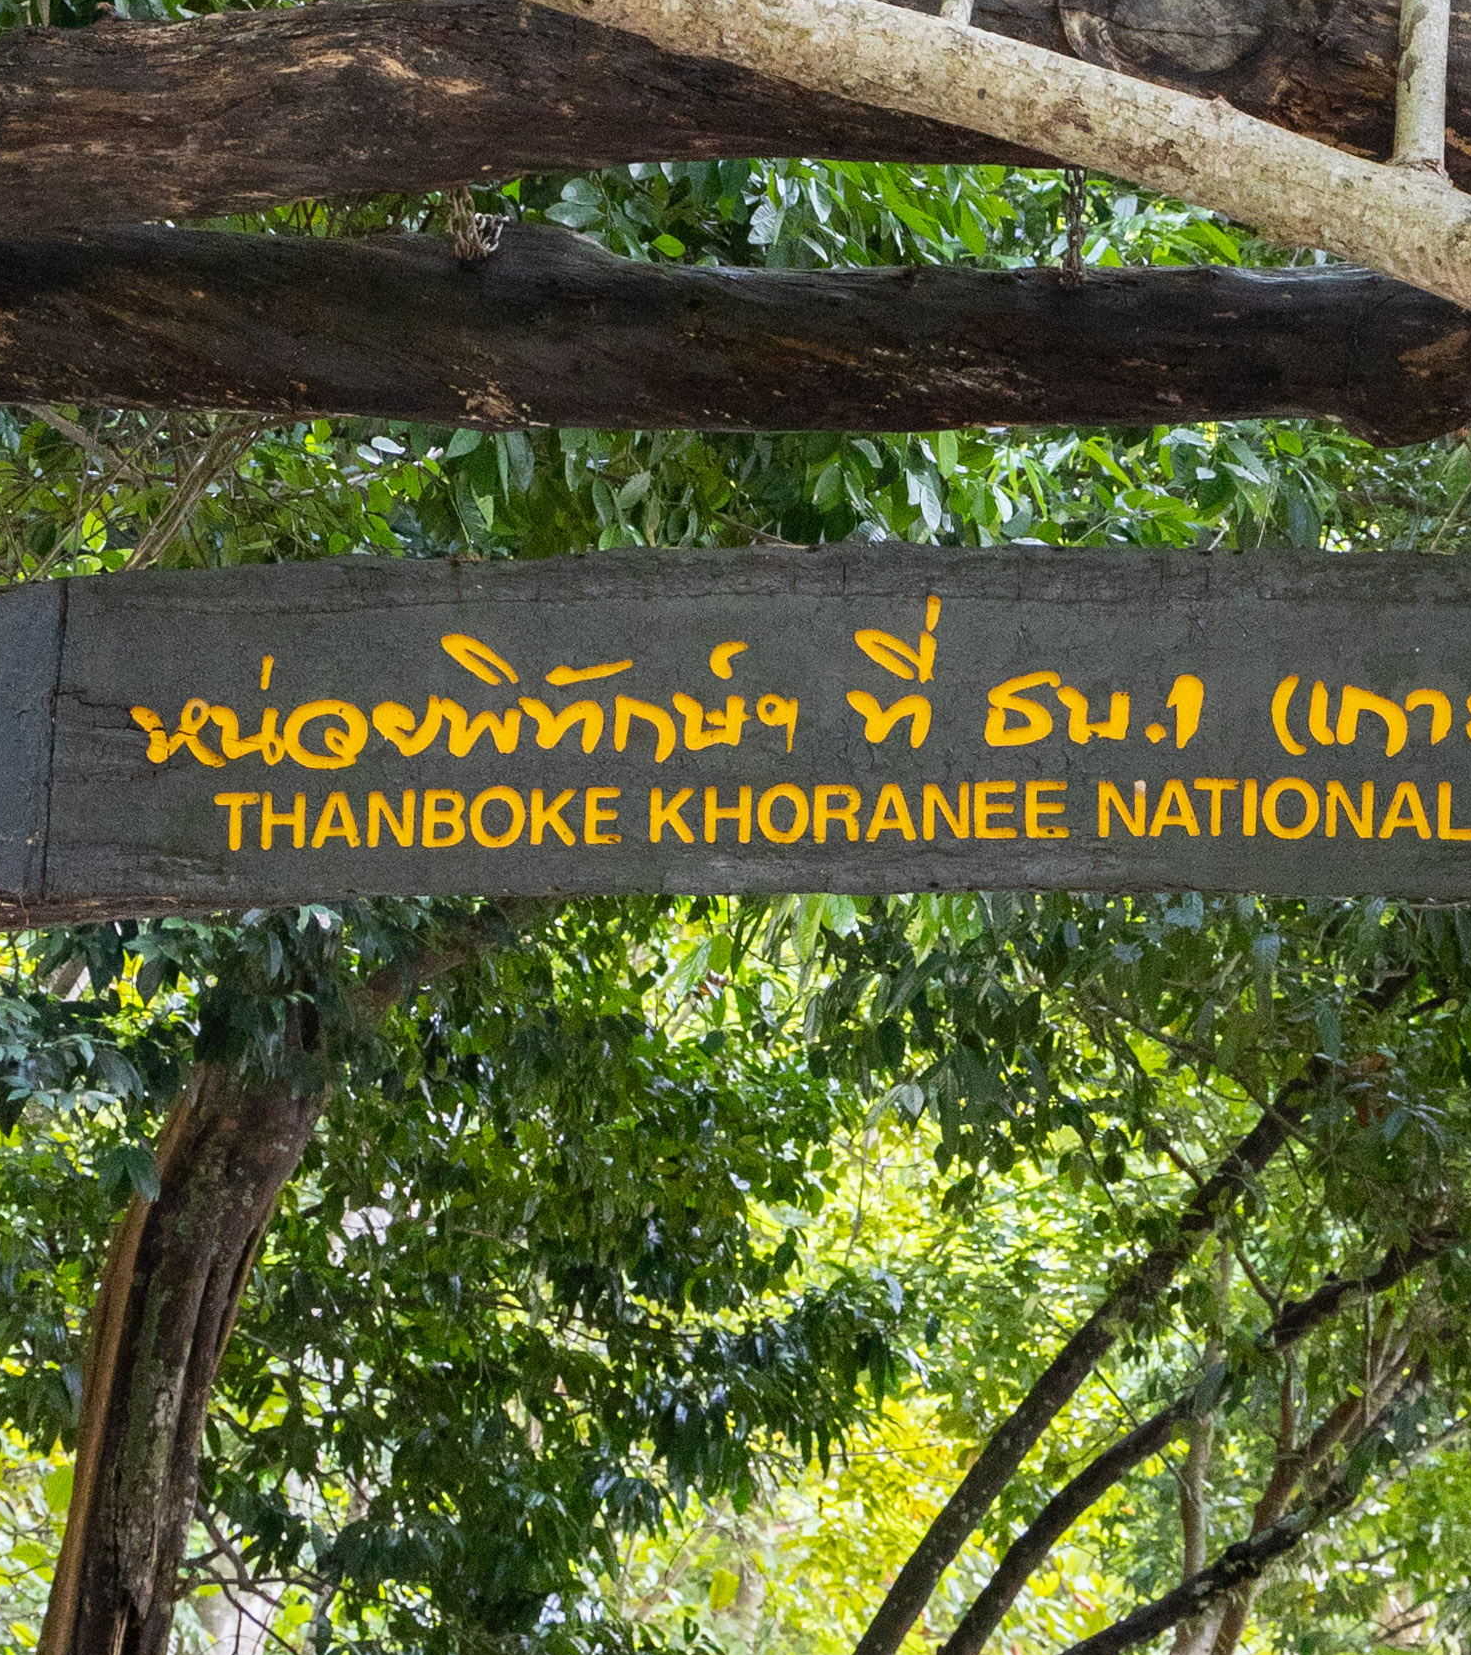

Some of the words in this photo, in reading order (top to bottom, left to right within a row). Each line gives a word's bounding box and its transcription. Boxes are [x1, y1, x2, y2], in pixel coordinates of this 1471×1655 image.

[845, 595, 942, 749] ที่
[213, 786, 622, 852] THANBOKE
[649, 779, 1071, 845] KHORANEE
